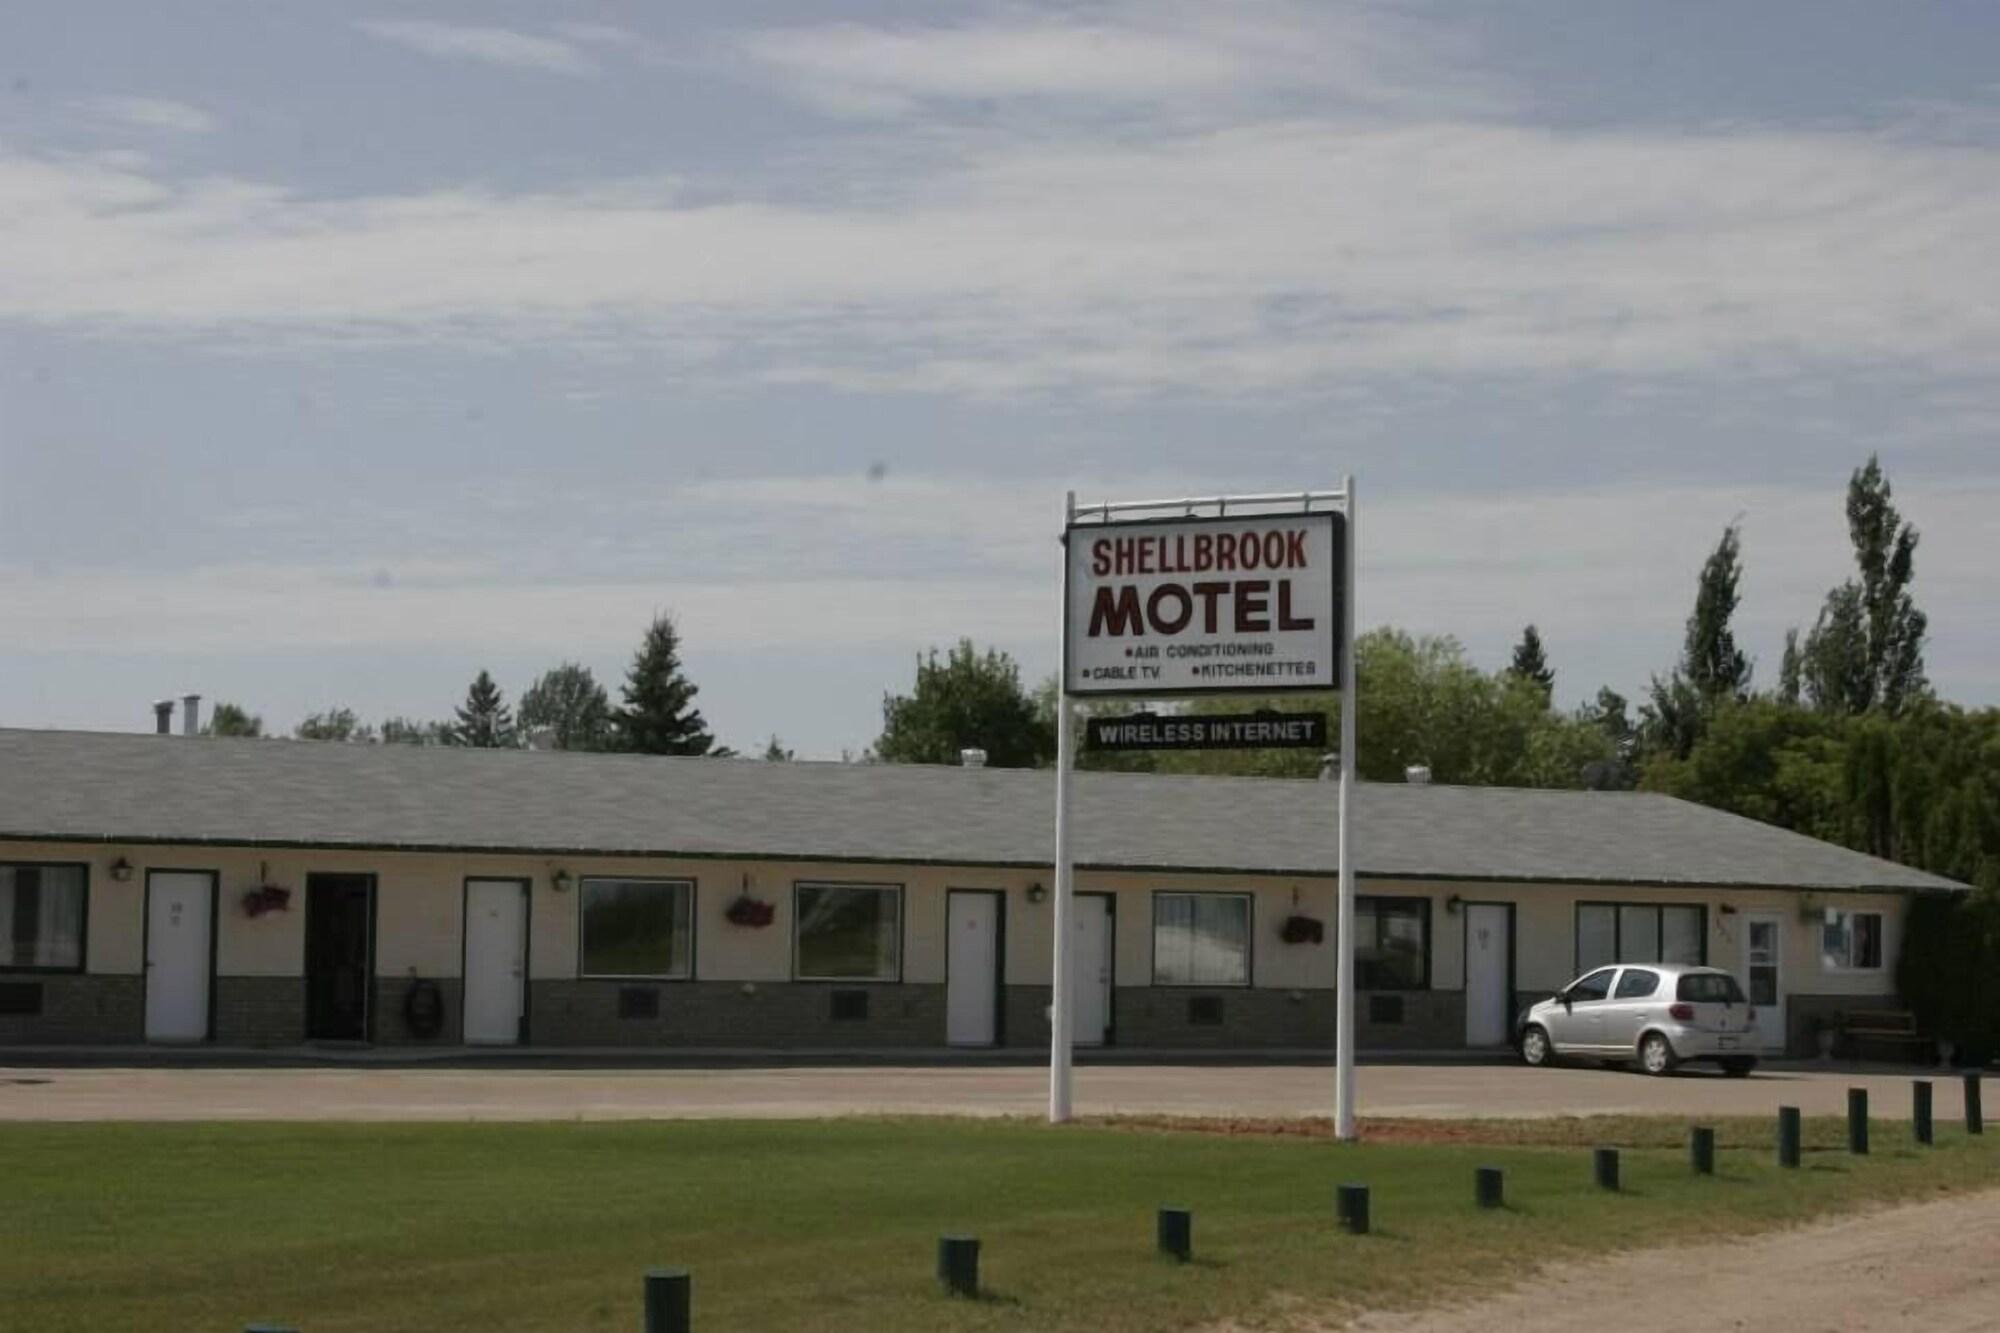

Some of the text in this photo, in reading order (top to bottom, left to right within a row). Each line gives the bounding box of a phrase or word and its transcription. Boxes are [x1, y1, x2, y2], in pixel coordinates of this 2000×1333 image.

[1092, 530, 1308, 577] SHELLBROOK
[1088, 579, 1315, 637] MOTEL
[1134, 642, 1274, 659] AIR CONDITIONING
[1093, 666, 1160, 680] CABLE TV
[1201, 661, 1316, 677] KITCHENETTES
[1099, 721, 1316, 743] WIRELESS INTERNET
